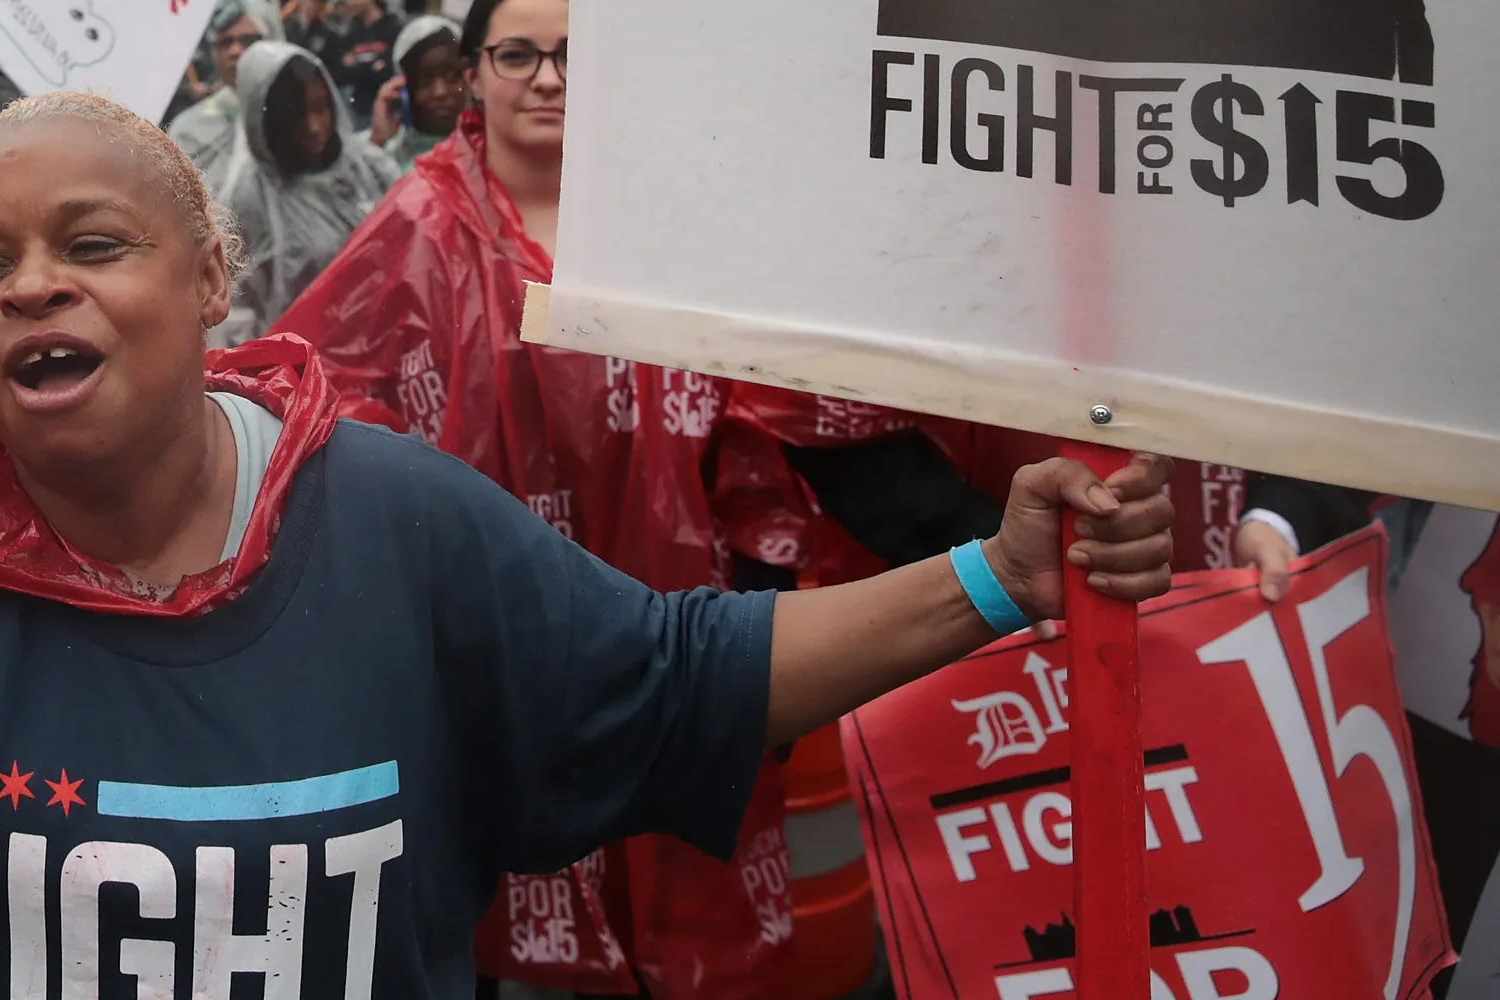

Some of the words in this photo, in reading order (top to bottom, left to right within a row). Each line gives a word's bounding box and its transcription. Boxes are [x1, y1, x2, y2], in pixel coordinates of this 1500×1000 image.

[869, 48, 1187, 195] FIGHT
[1136, 101, 1174, 196] FOR
[1190, 73, 1445, 221] $15
[1196, 565, 1417, 1000] 15
[508, 877, 576, 922] POR
